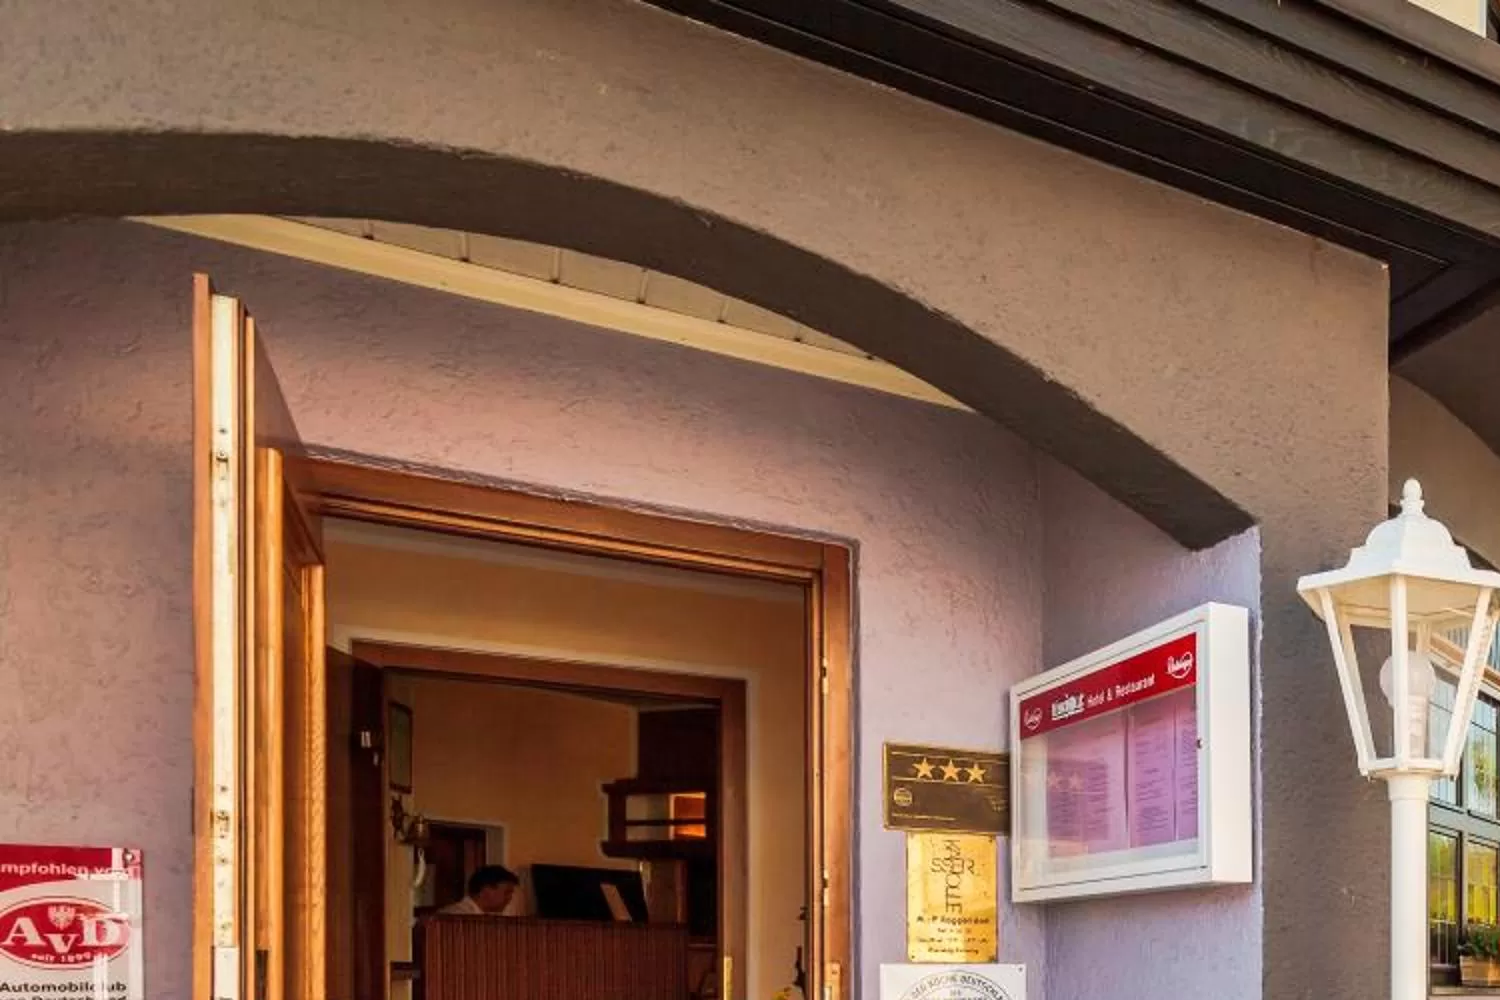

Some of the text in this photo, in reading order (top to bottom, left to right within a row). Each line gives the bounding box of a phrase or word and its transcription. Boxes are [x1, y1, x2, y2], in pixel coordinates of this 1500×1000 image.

[0, 862, 88, 876] mpfohlen
[0, 917, 121, 953] AvD
[0, 981, 127, 993] Automobilcub
